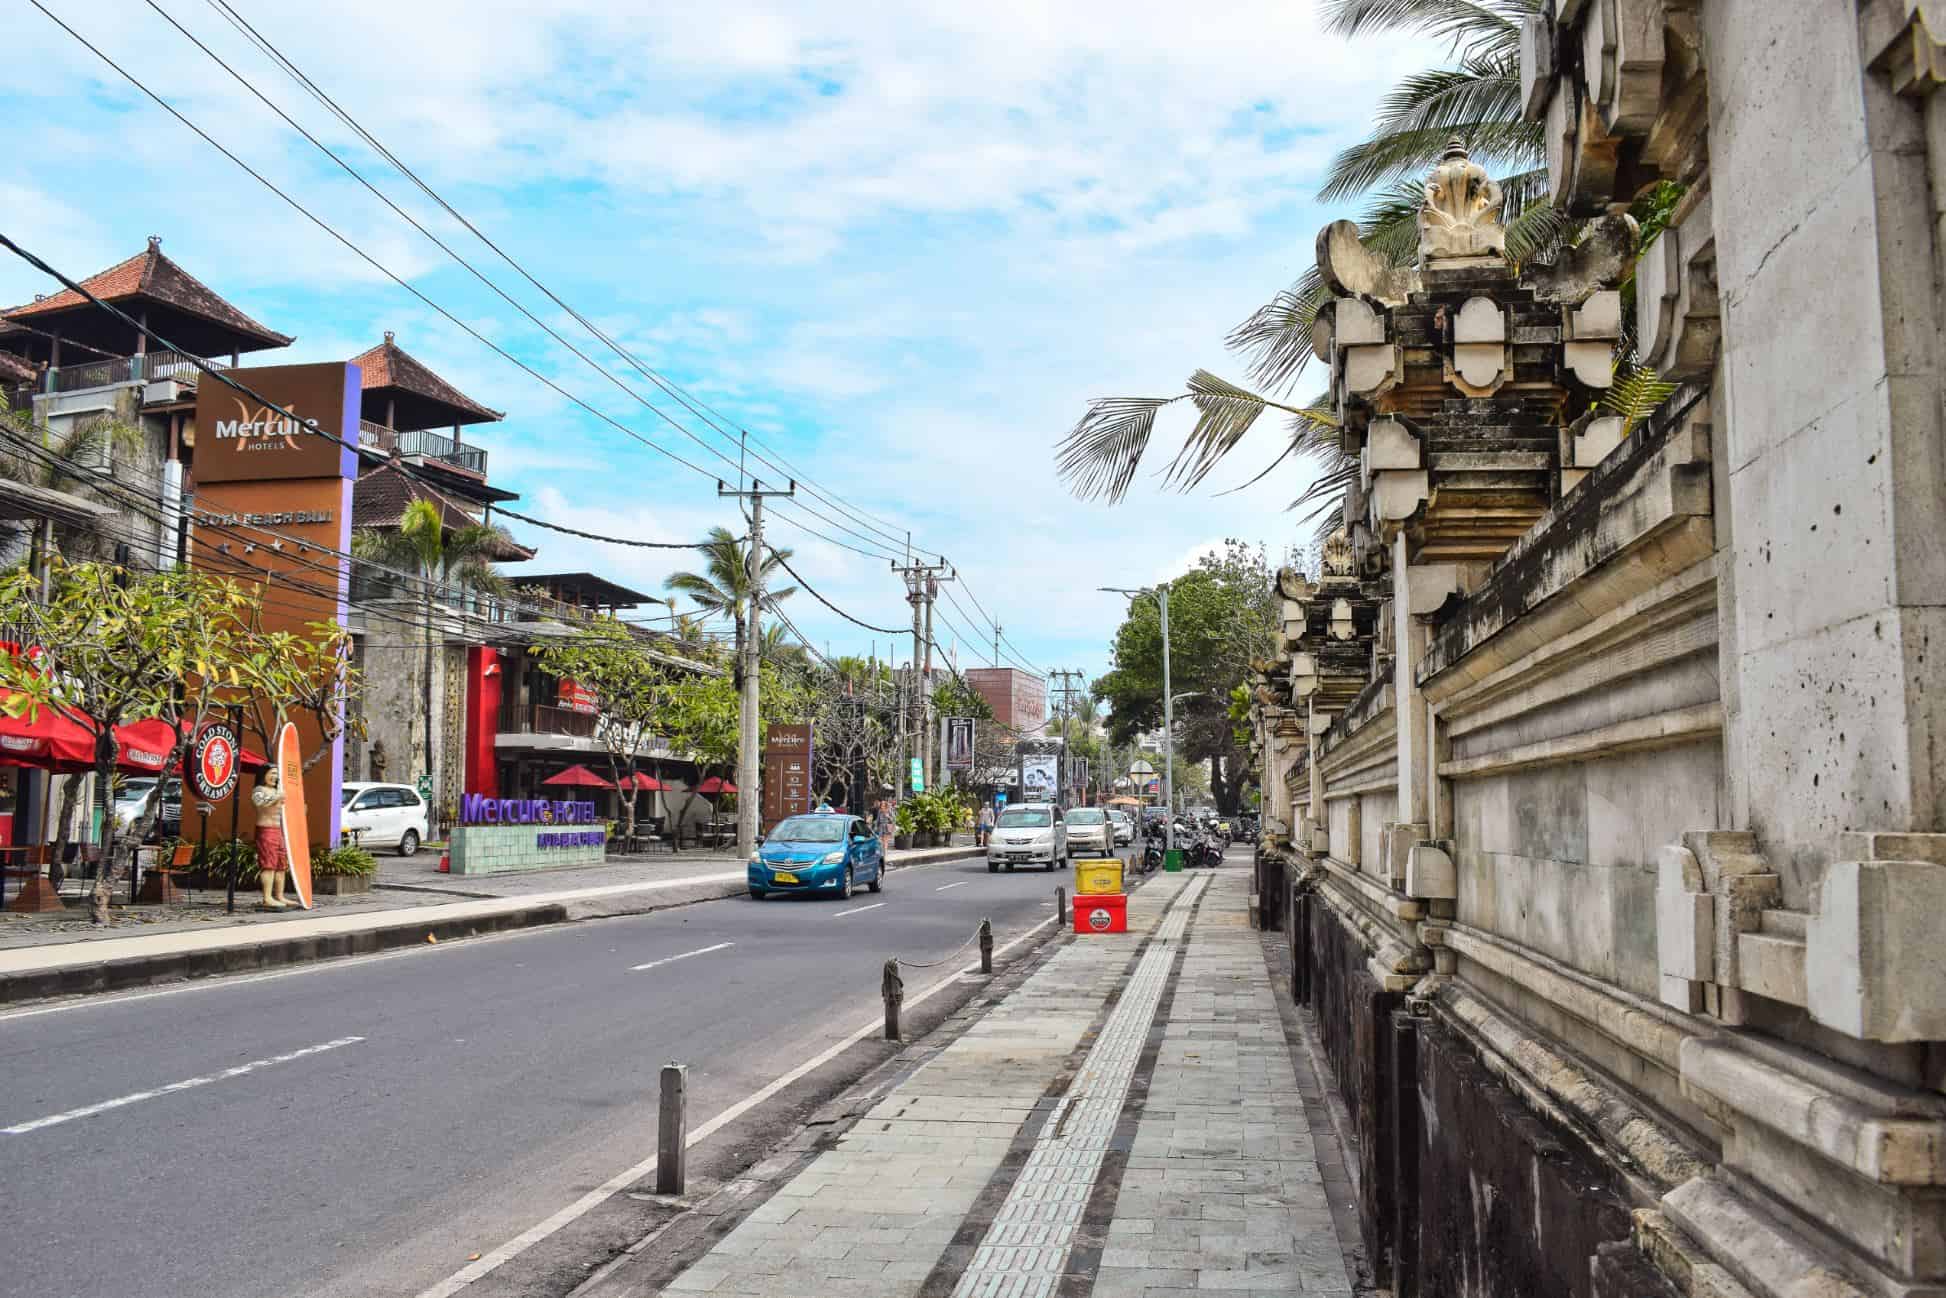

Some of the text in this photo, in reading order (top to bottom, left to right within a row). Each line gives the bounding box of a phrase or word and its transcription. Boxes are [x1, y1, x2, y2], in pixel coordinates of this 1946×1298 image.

[215, 418, 319, 438] Mercure
[248, 441, 286, 451] HOTELS
[216, 725, 239, 758] STONE
[196, 769, 238, 800] CREAMERY
[461, 793, 597, 824] Mercure HOTEL
